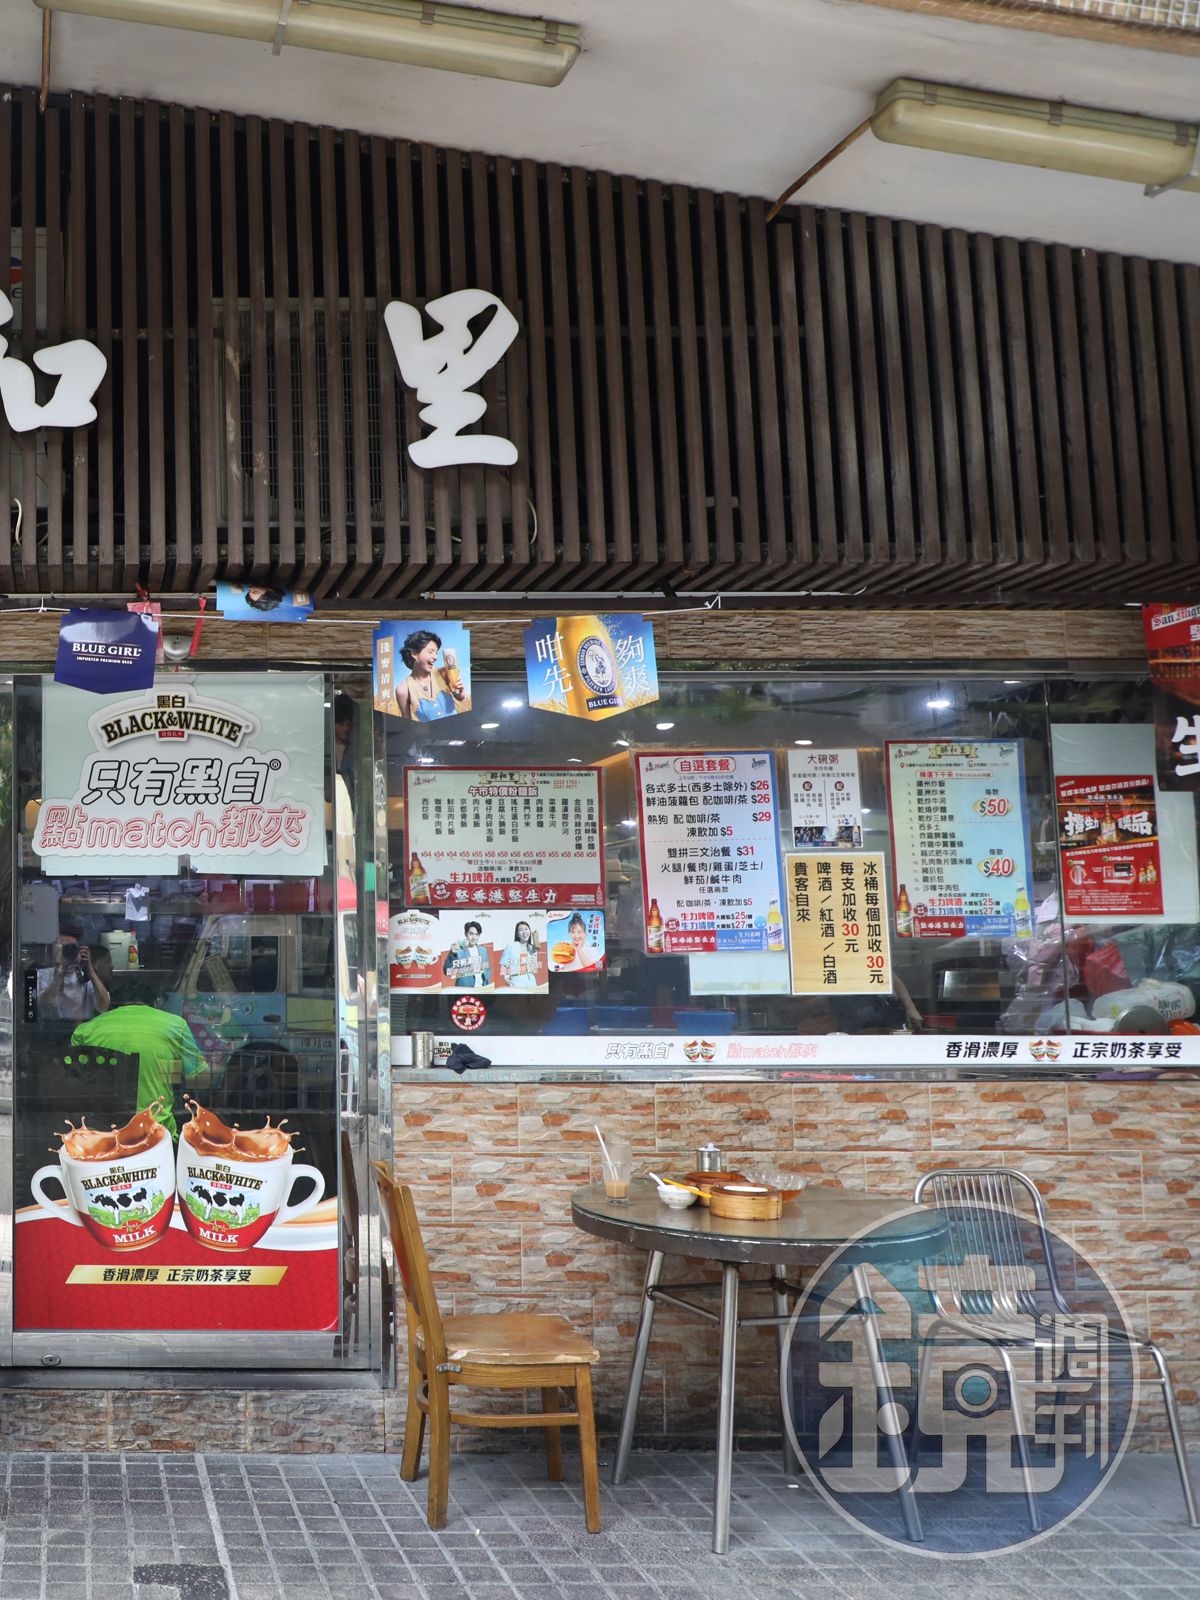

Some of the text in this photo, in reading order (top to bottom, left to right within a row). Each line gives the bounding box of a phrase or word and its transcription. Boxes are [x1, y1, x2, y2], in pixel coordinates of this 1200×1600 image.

[72, 643, 141, 656] BLUE GIRL
[157, 695, 185, 708] 黑白
[588, 698, 608, 709] BLUE
[101, 711, 243, 743] BLACK&WHITE
[680, 760, 730, 772] 自選套餐
[807, 754, 839, 765] 大碗粥
[81, 757, 271, 806] 只有黑白
[645, 781, 769, 793] 各式多士(西多士除外) $26
[468, 786, 538, 797] 午市特價粉麵飯
[702, 795, 748, 806] 配咖啡/茶
[751, 794, 770, 804] $26
[979, 799, 1007, 814] $50
[648, 812, 771, 825] 熱狗 配 咖啡/茶 $29
[667, 846, 755, 858] 雙拼三文治餐 $31
[983, 858, 1012, 874] $40
[450, 872, 494, 883] 生力啤酒
[793, 862, 811, 922] 貴客自來
[840, 862, 860, 953] 每支加收30元
[681, 912, 715, 921] 生力啤酒
[863, 862, 884, 984] 冰桶每個加收30元
[604, 1042, 671, 1059] 只有黑白
[946, 1042, 1182, 1059] 香滑濃厚 正宗奶茶享受
[109, 1165, 125, 1174] 黑白
[215, 1164, 230, 1172] 黑白
[81, 1168, 157, 1190] BLACK&WHITE
[187, 1166, 263, 1190] BLACK&WHITE
[112, 1225, 156, 1244] MILK
[198, 1227, 239, 1243] MILK
[103, 1268, 252, 1282] 香滑濃厚 正宗奶茶享受
